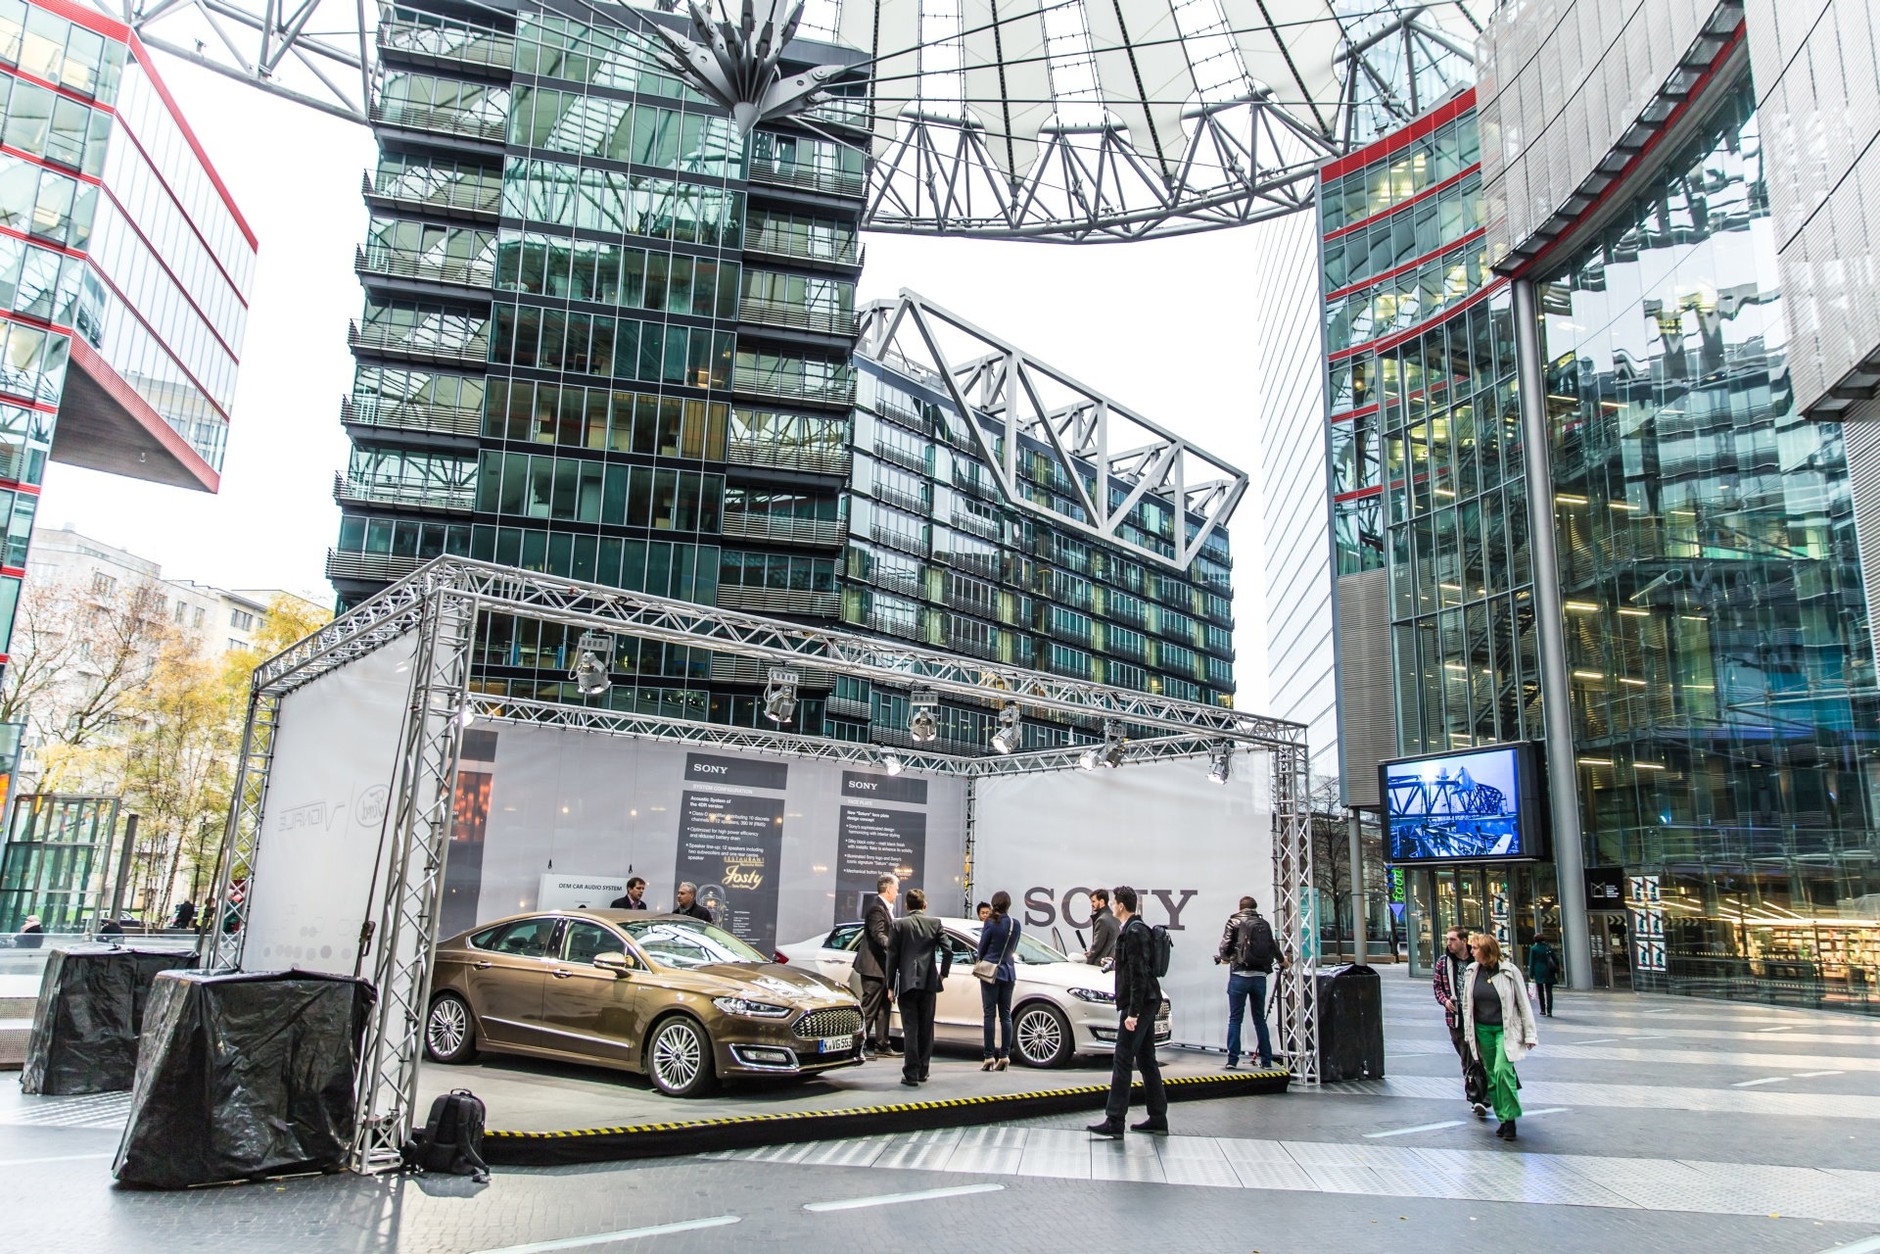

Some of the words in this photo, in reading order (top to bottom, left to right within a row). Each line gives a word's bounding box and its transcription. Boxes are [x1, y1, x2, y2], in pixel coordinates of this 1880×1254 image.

[694, 764, 728, 774] SONY
[714, 786, 752, 794] CONFIGURATION
[848, 780, 878, 790] SONY
[722, 865, 764, 890] Josty
[1392, 868, 1405, 902] food
[1024, 886, 1198, 930] SOY
